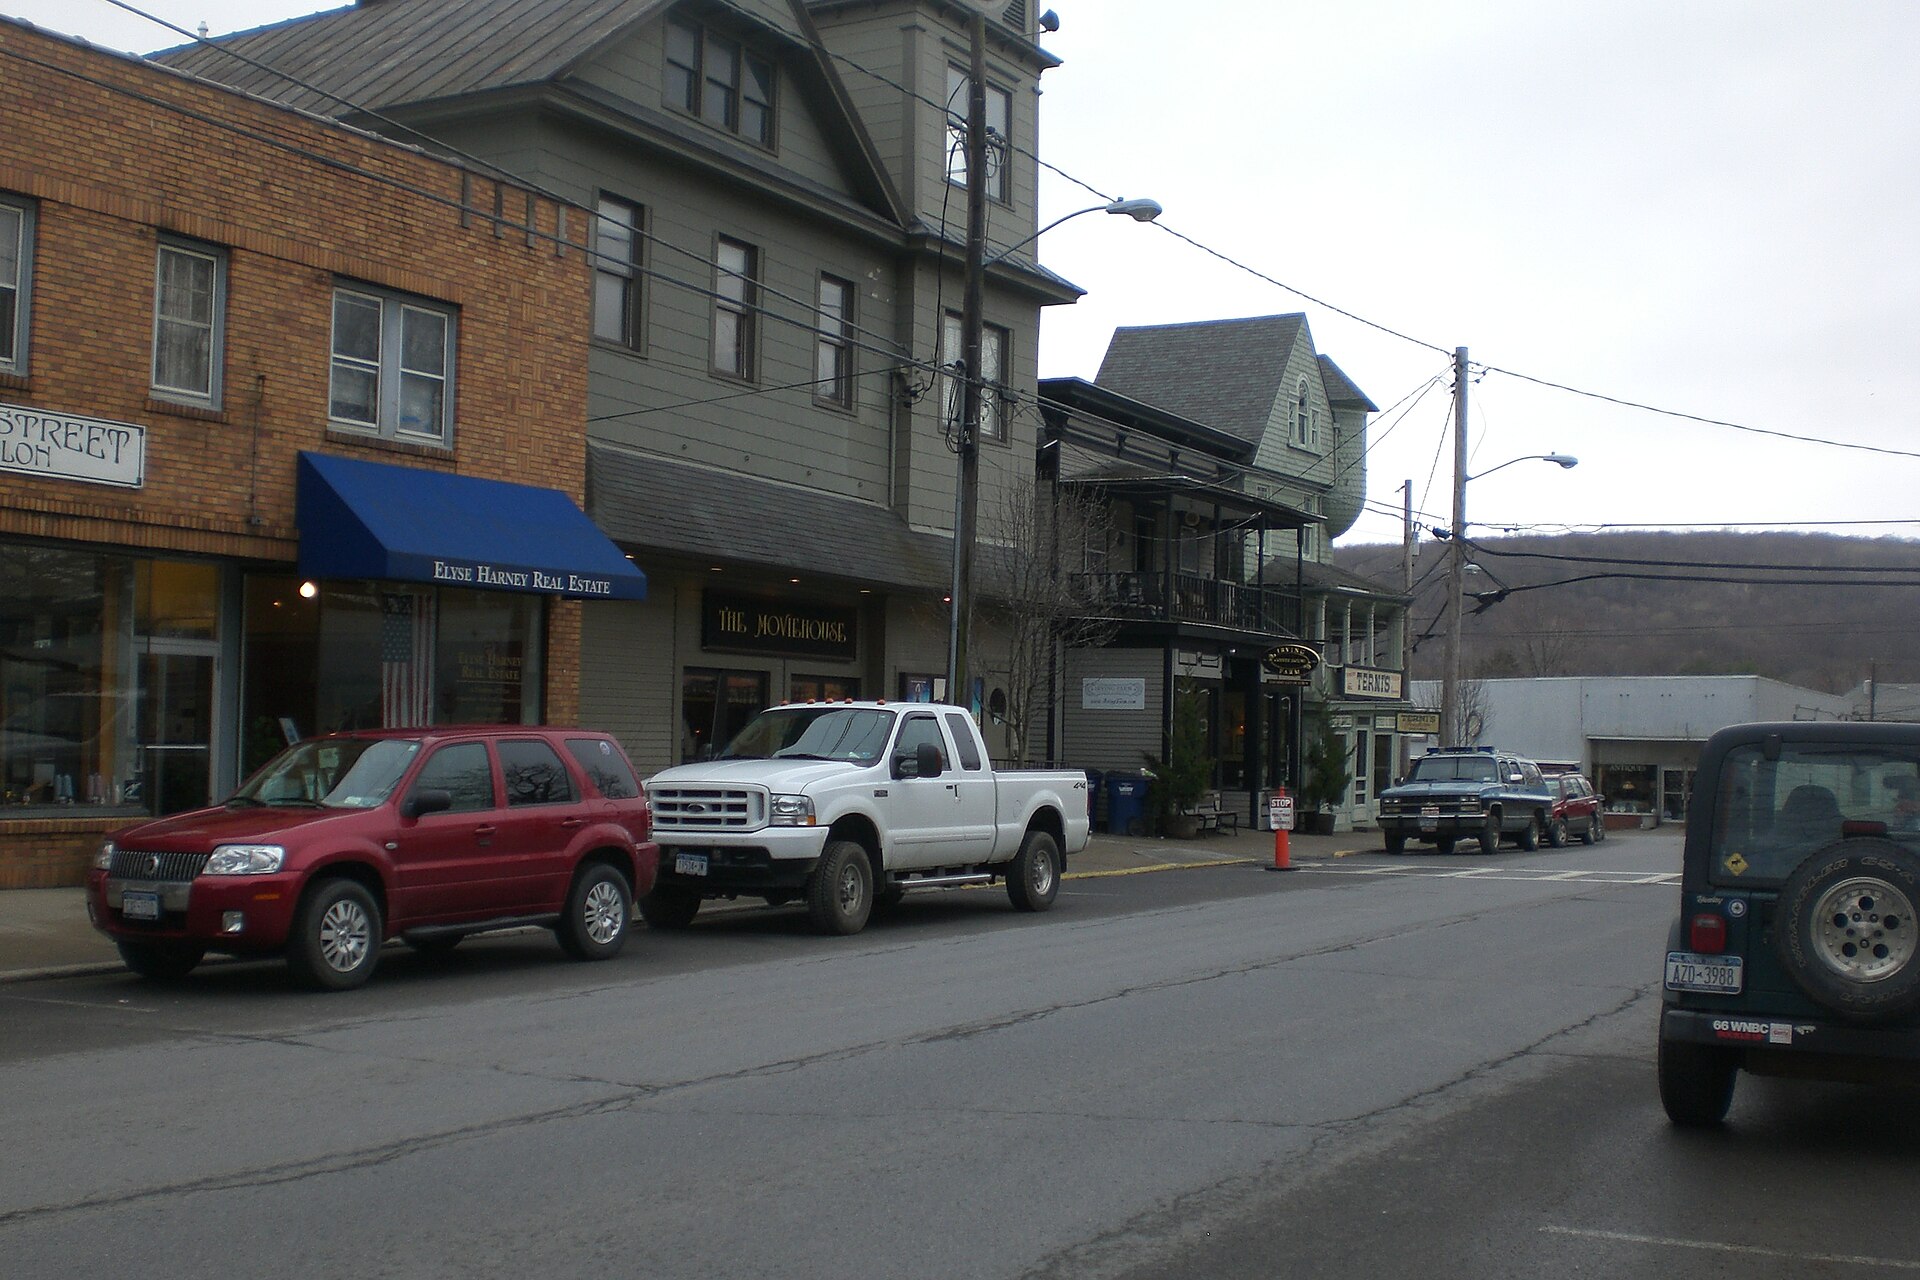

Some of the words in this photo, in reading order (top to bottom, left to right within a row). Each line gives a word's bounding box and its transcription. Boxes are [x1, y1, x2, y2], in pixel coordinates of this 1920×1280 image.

[0, 411, 130, 464] STREET
[434, 561, 472, 581] ELYSE
[477, 565, 528, 587] HARNEY
[533, 571, 564, 590] REAL
[568, 574, 610, 594] ESTATE
[719, 606, 747, 633] THE
[754, 614, 847, 642] MOVIEHOUSE
[1277, 647, 1306, 655] IRVING
[1271, 799, 1291, 807] STOP
[1712, 1020, 1729, 1031] 66
[1730, 1021, 1770, 1034] WNBC
